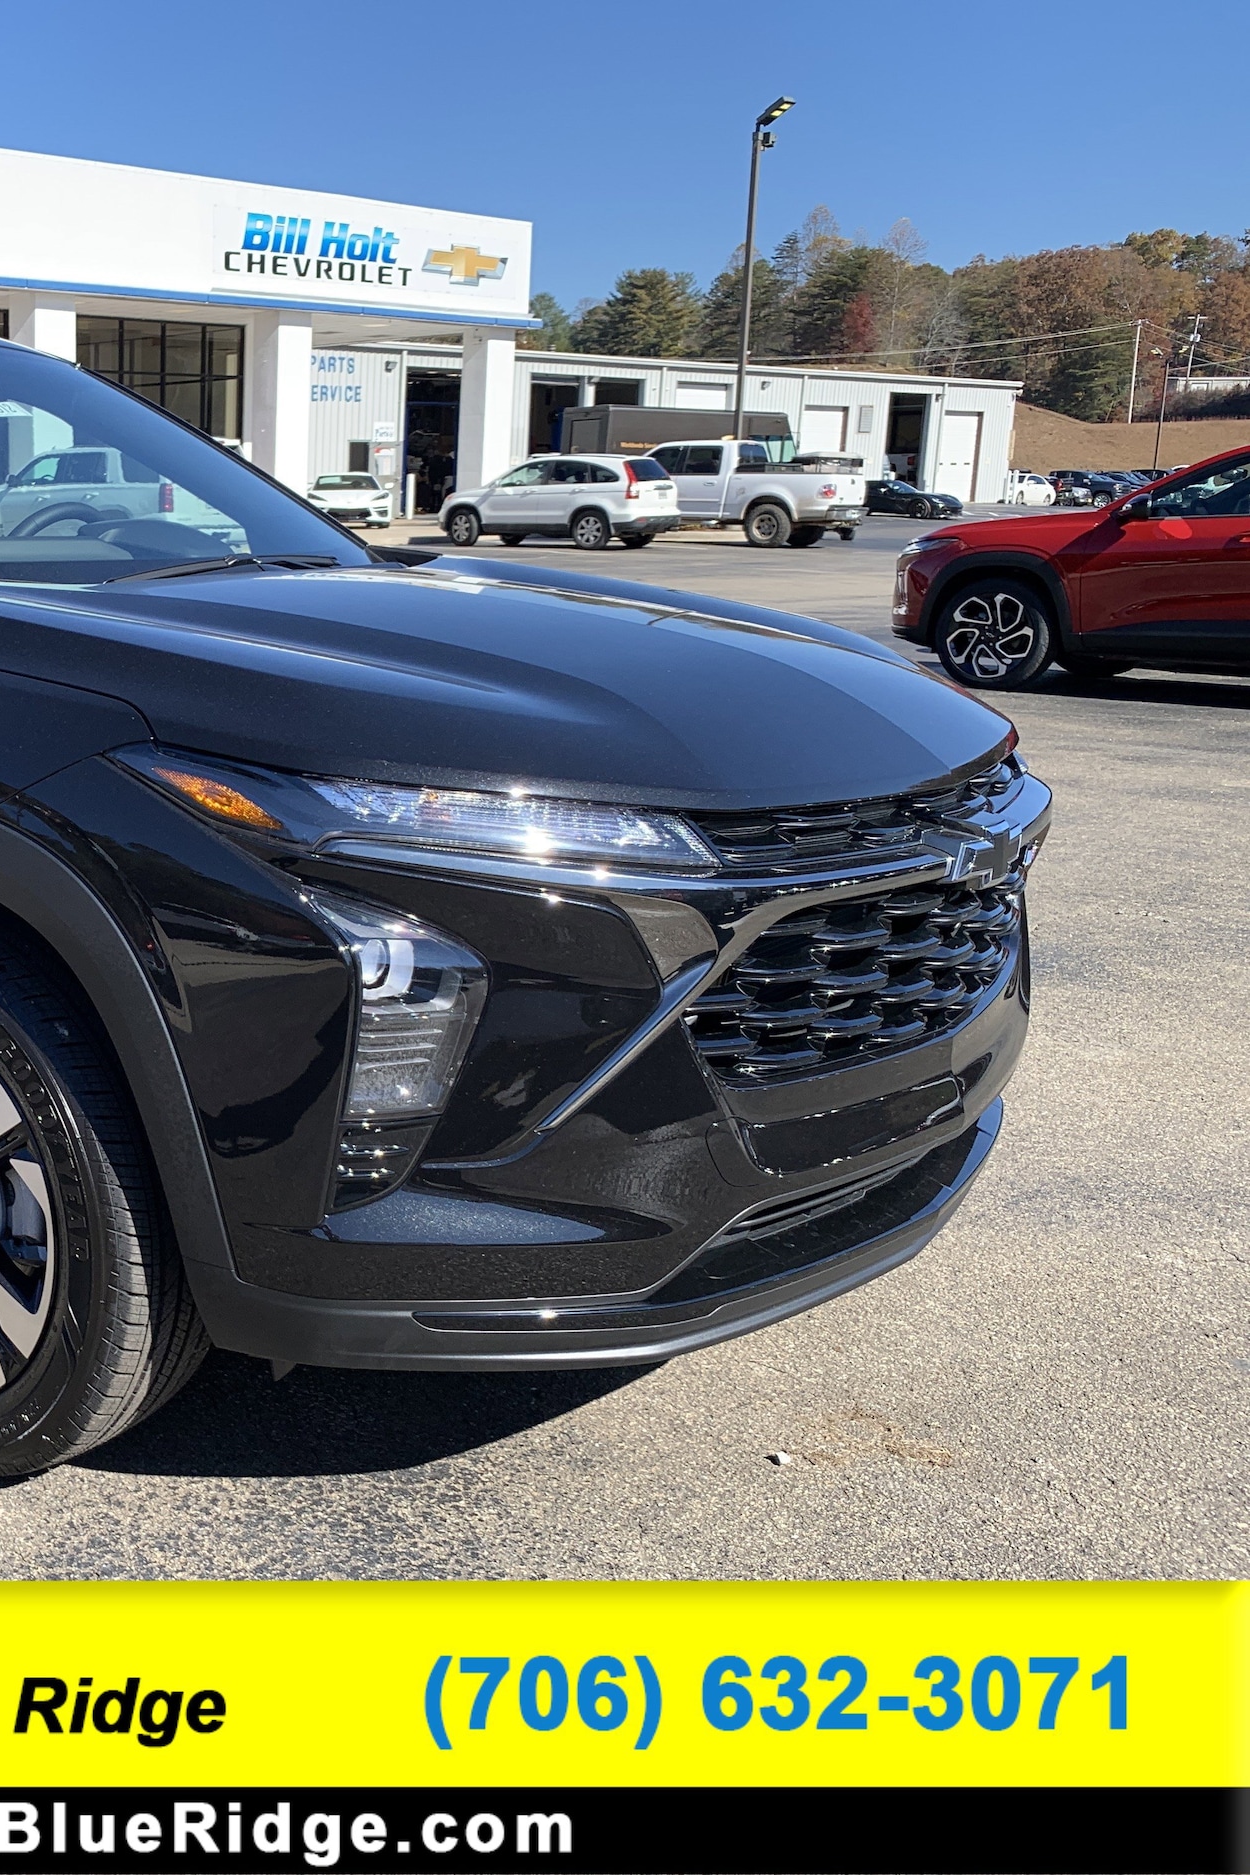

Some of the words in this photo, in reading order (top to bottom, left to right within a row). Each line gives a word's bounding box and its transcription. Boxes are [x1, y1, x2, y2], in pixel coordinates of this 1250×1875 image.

[241, 212, 311, 255] Bill
[319, 221, 400, 264] Holt
[224, 251, 412, 286] CHEVROLET
[310, 385, 362, 403] ERVICE
